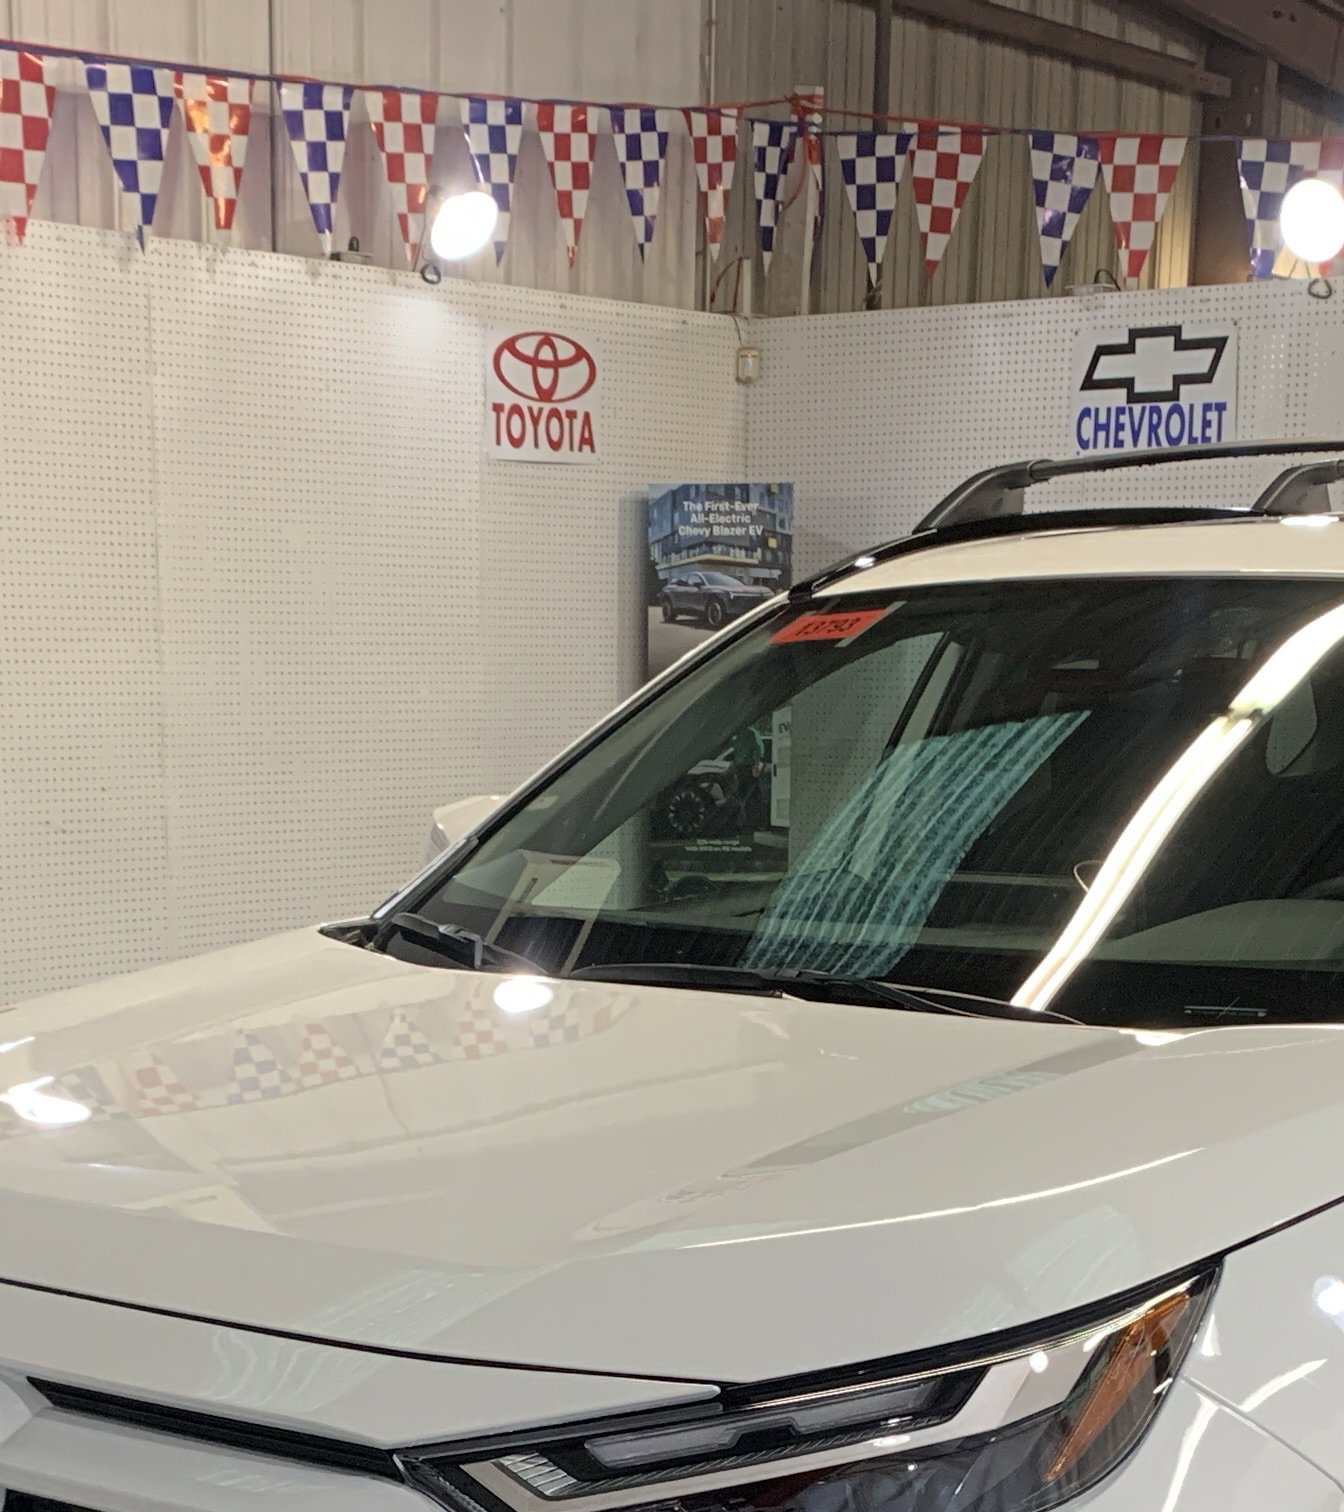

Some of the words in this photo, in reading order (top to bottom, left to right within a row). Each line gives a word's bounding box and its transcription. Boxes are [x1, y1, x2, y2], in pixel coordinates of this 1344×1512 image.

[492, 402, 596, 454] TOYOTA
[1076, 402, 1227, 450] CHEVROLET
[682, 501, 703, 512] The
[690, 513, 751, 523] All-Electric
[678, 525, 711, 537] Chevy
[713, 525, 747, 536] Blazer
[749, 525, 763, 536] EV
